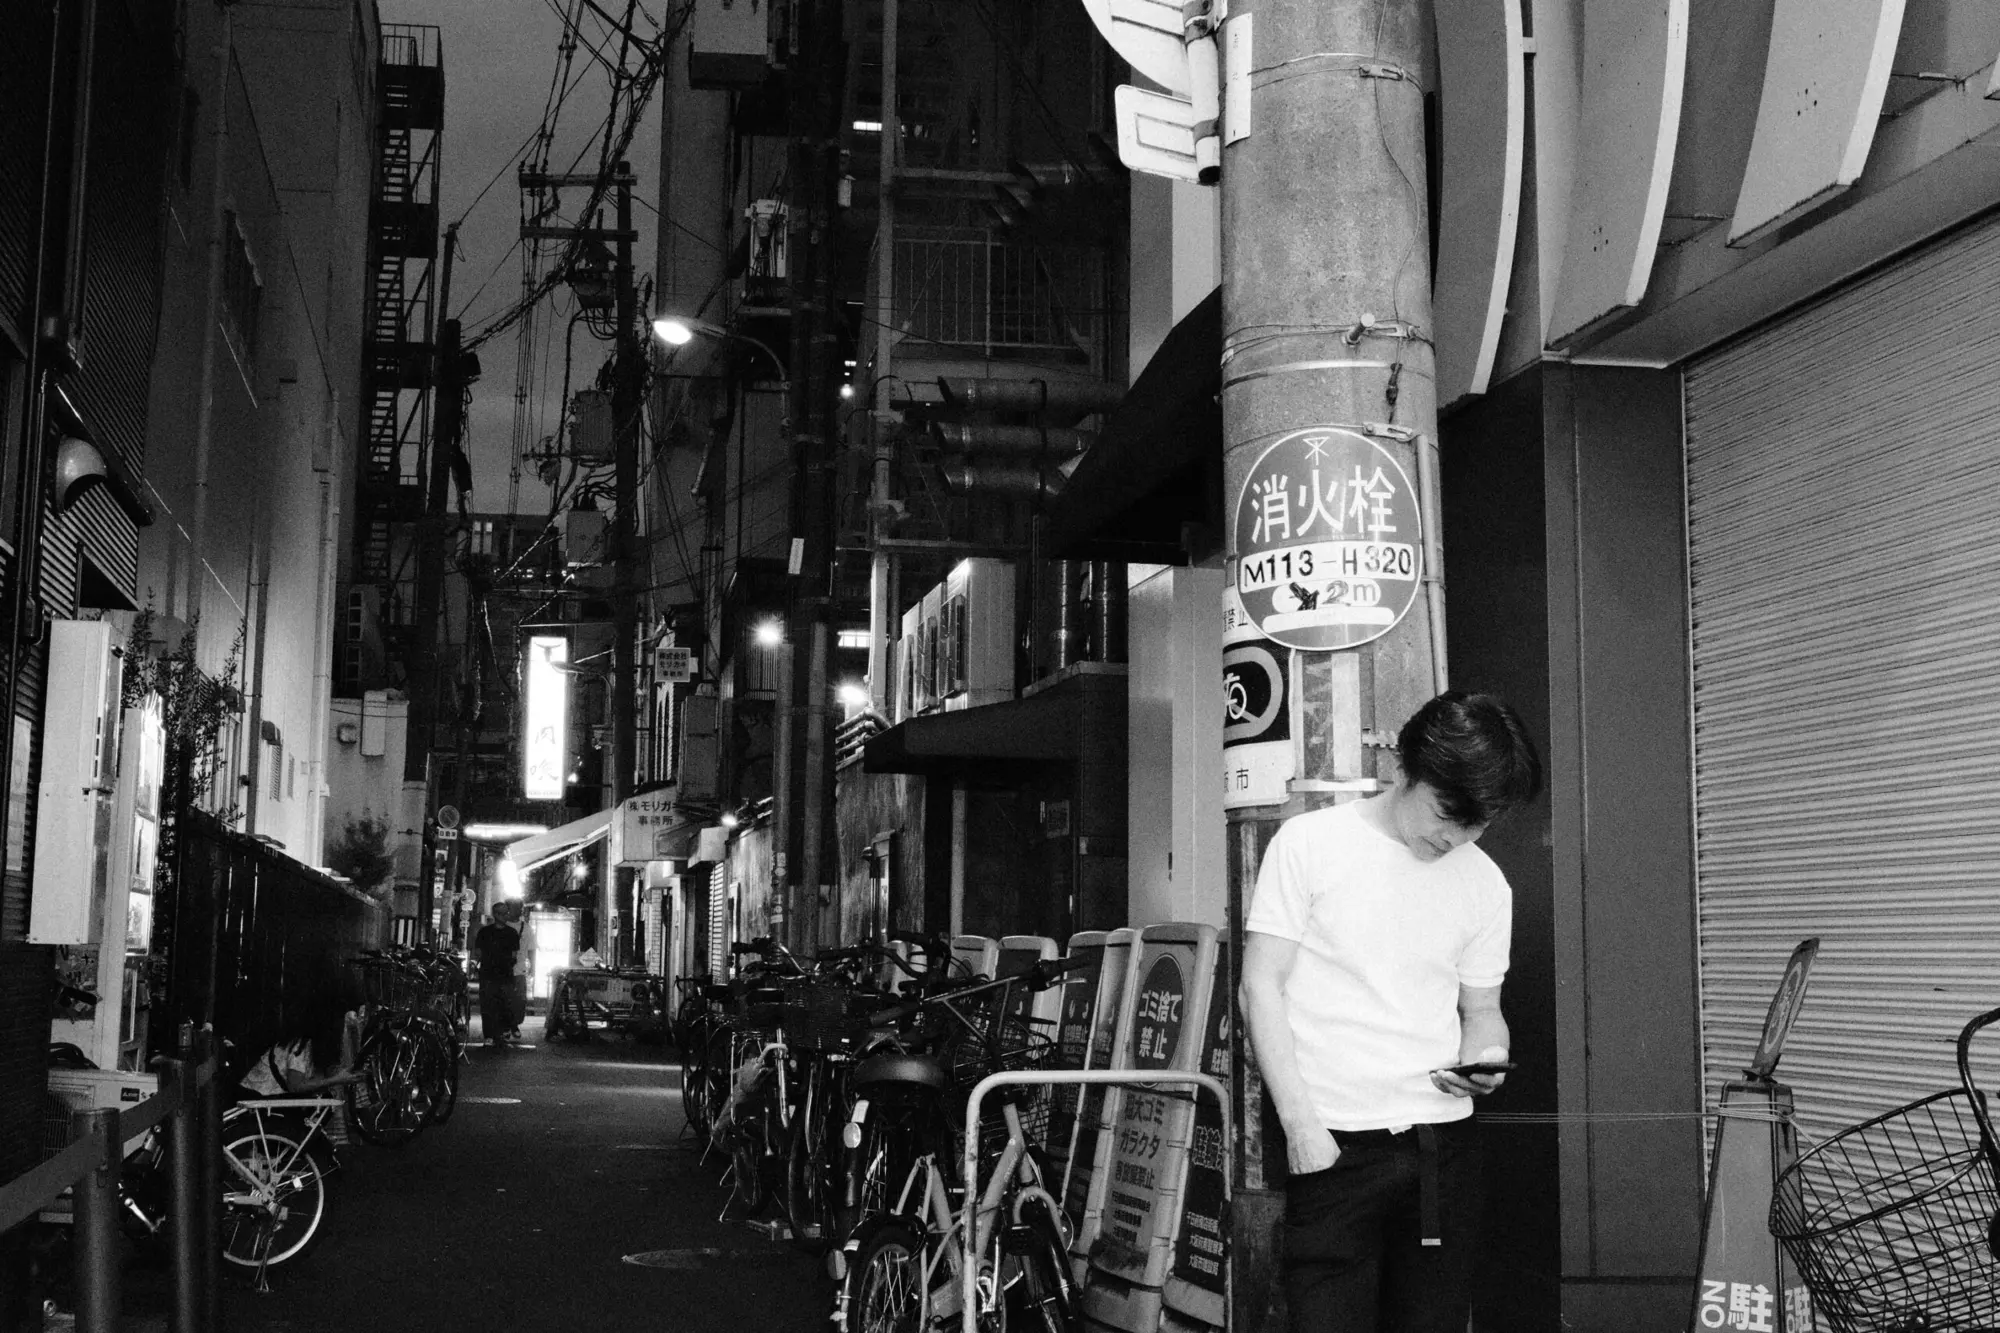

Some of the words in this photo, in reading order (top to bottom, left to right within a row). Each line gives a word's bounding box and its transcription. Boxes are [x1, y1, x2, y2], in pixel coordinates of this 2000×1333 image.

[1250, 465, 1397, 544] 消火栓
[1138, 990, 1183, 1023] ゴミ捨て
[1138, 1026, 1167, 1060] 禁止
[1118, 1128, 1160, 1160] ガラクタ
